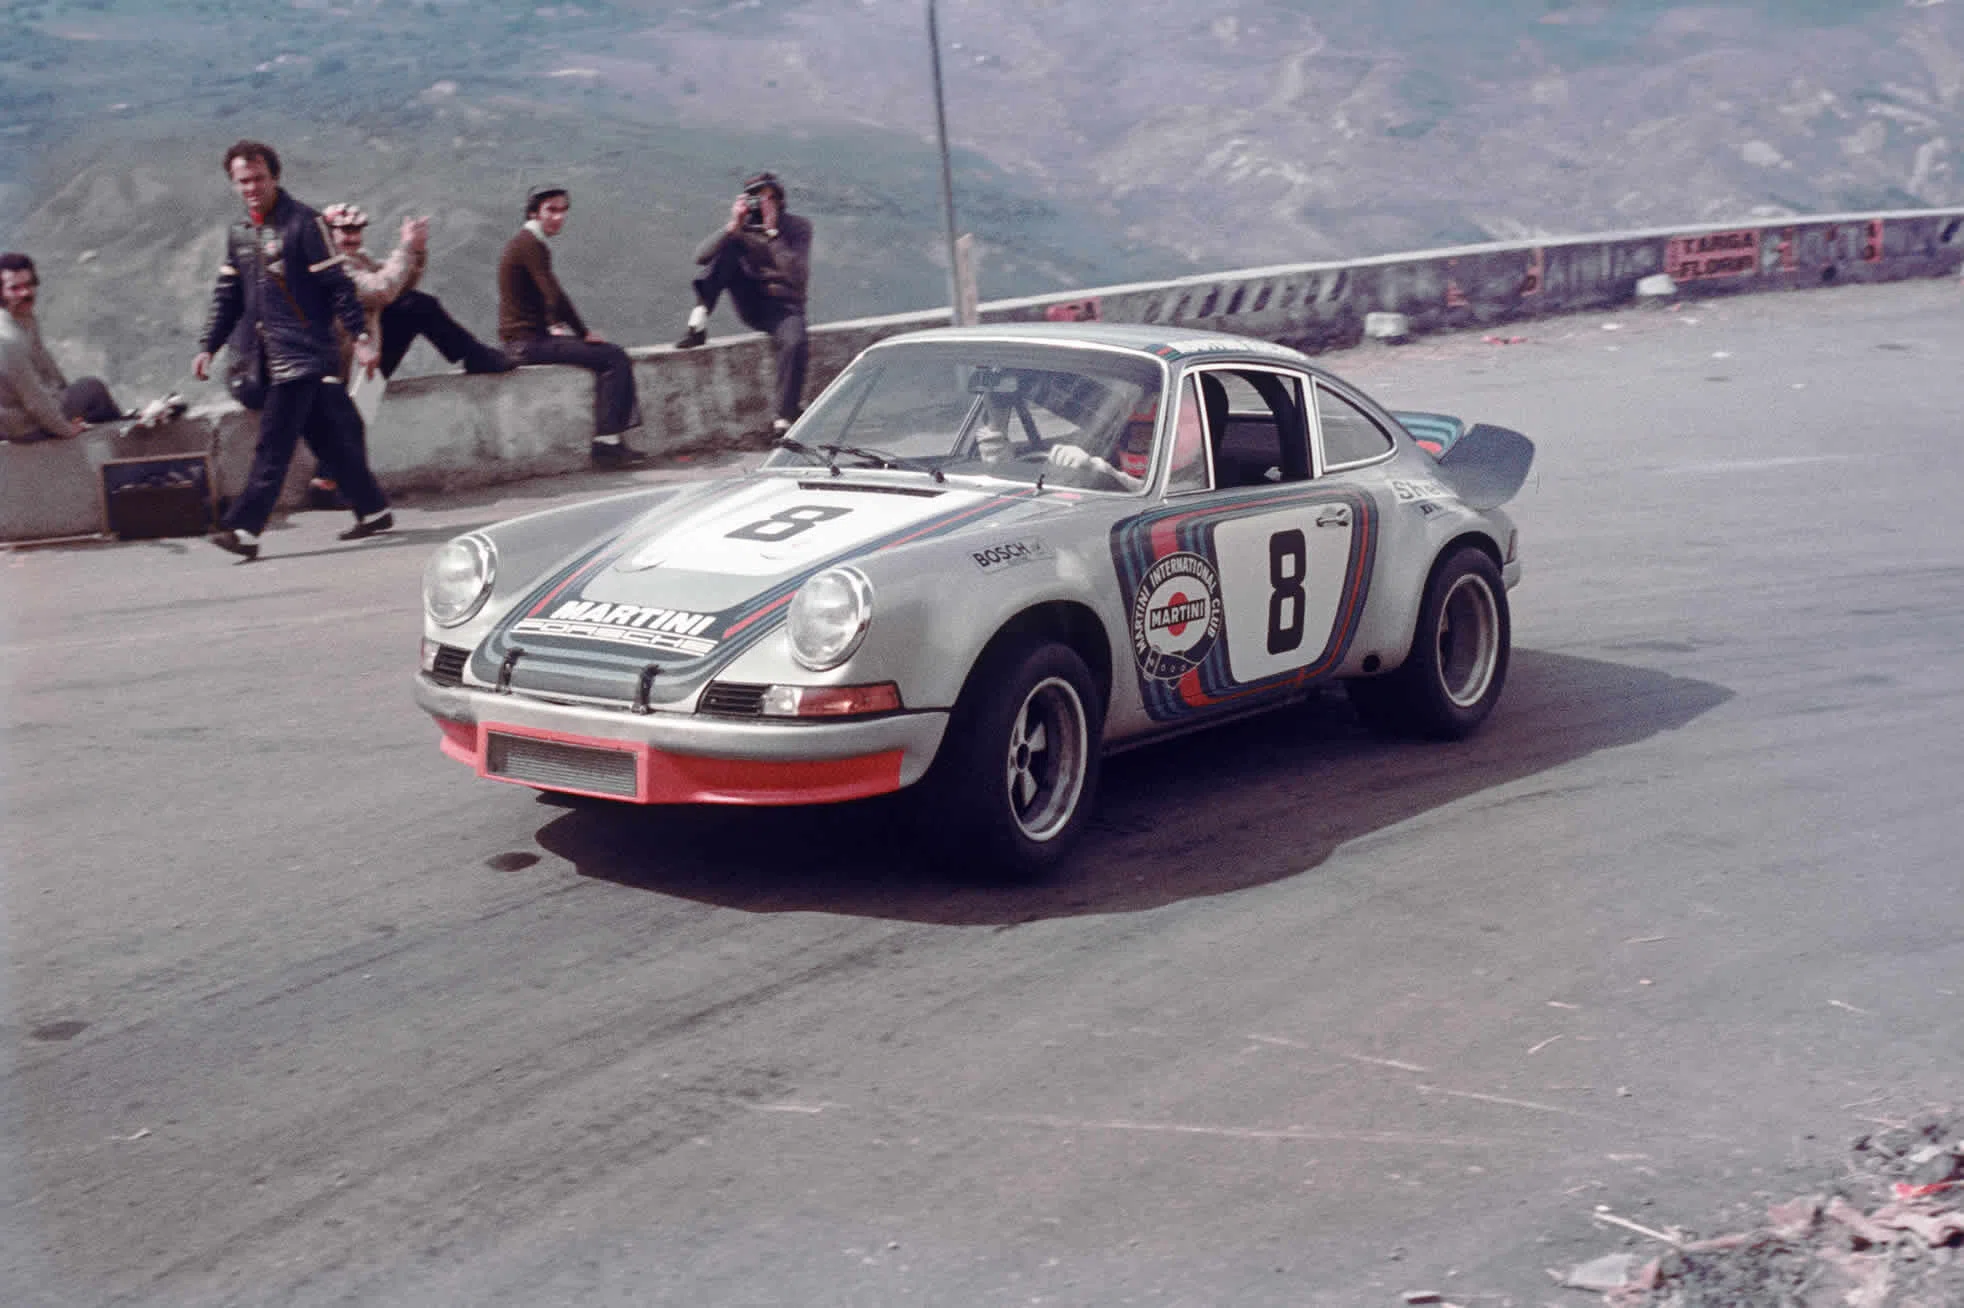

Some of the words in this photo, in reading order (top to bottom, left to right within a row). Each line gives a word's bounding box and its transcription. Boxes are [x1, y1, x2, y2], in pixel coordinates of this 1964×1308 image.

[723, 504, 854, 542] 8
[973, 542, 1031, 567] BOSCH
[1134, 584, 1151, 656] MARTINI
[1149, 556, 1217, 594] INTERNATIONAL
[1207, 598, 1221, 638] CLUB
[1267, 528, 1306, 655] 8
[550, 600, 717, 636] MARTINI
[1150, 600, 1205, 628] MARTINI
[510, 618, 718, 656] PORSCHE
